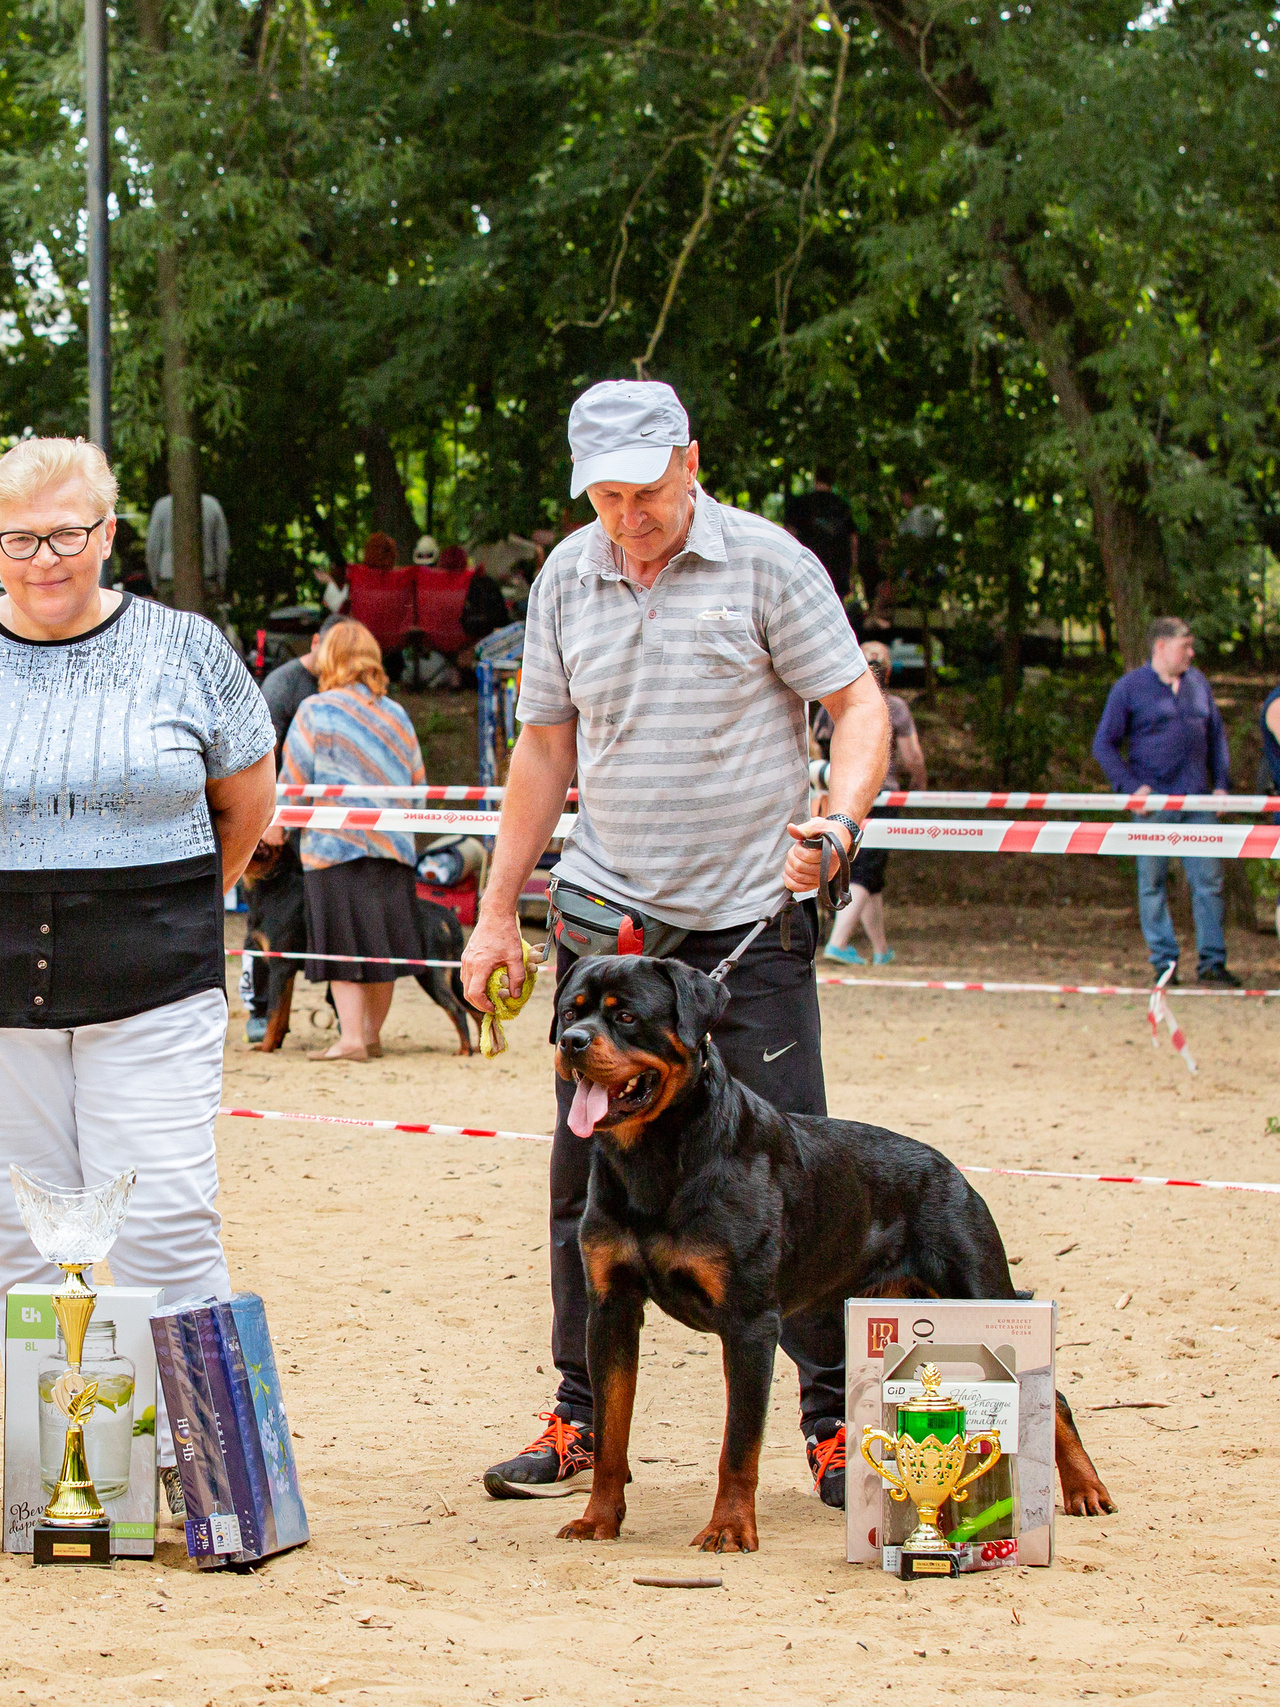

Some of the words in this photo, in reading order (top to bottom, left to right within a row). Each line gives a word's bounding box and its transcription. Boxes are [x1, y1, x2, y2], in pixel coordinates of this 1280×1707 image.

[403, 812, 443, 821] СЕРВИС
[887, 826, 925, 835] СЕРВИС
[942, 828, 983, 836] ВОСТОК
[1128, 833, 1165, 842] СЕРВИС
[1182, 835, 1223, 843] ВОСТОК
[24, 1342, 38, 1352] 8L
[887, 1386, 906, 1395] GiD
[950, 1388, 982, 1402] Набор
[969, 1398, 1011, 1413] посуды
[175, 1417, 195, 1462] НОЧЬ
